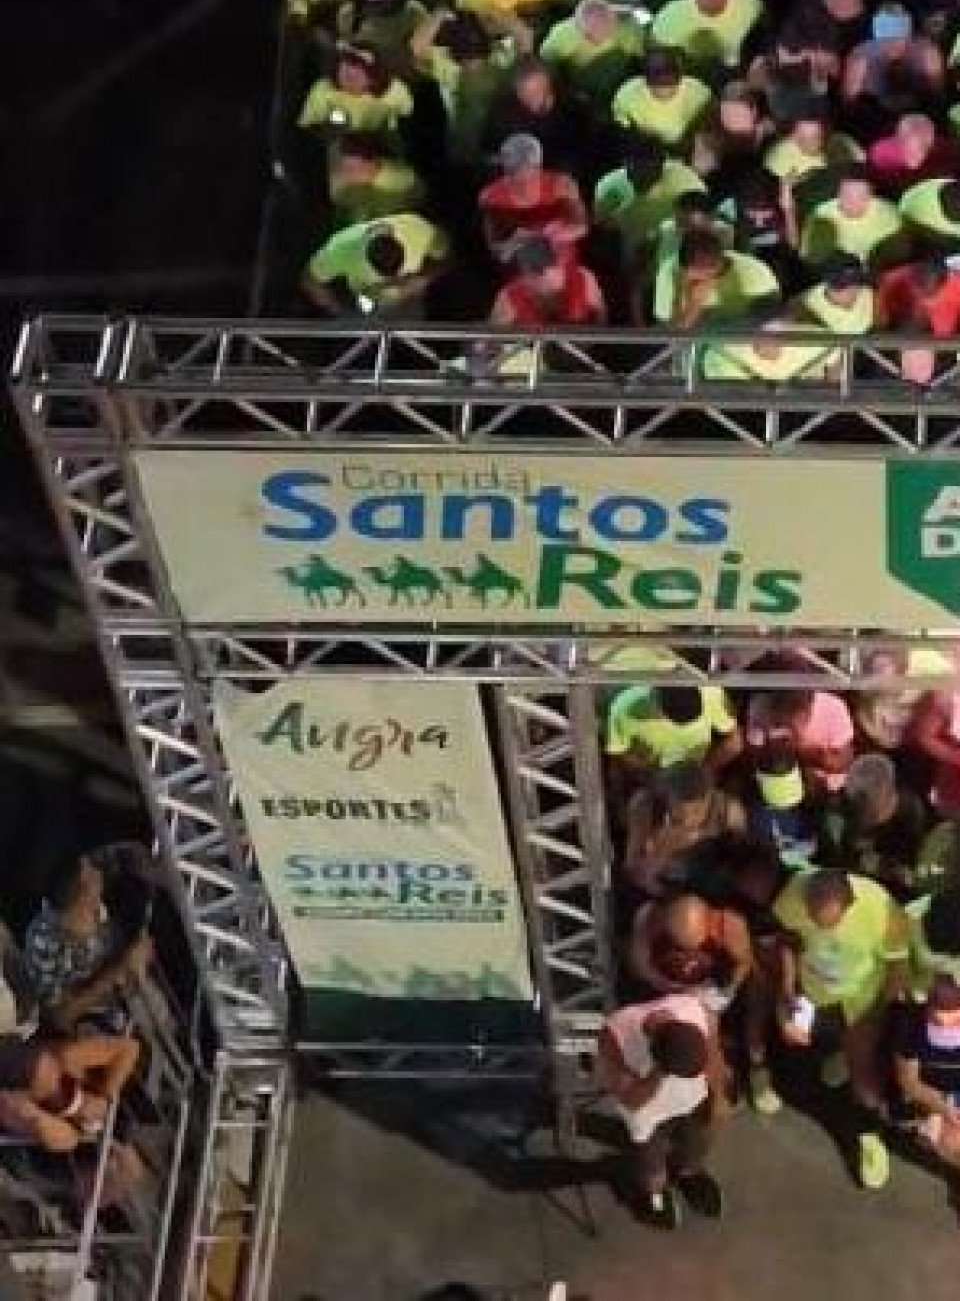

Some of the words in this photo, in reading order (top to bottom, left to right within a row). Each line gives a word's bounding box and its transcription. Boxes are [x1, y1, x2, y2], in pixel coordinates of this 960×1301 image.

[341, 462, 530, 492] Corrida
[261, 471, 729, 545] Santos
[535, 544, 803, 614] Reis
[256, 701, 448, 771] Angra
[259, 797, 431, 821] ESPORTES
[285, 853, 473, 883] Santos
[398, 882, 509, 905] Reis
